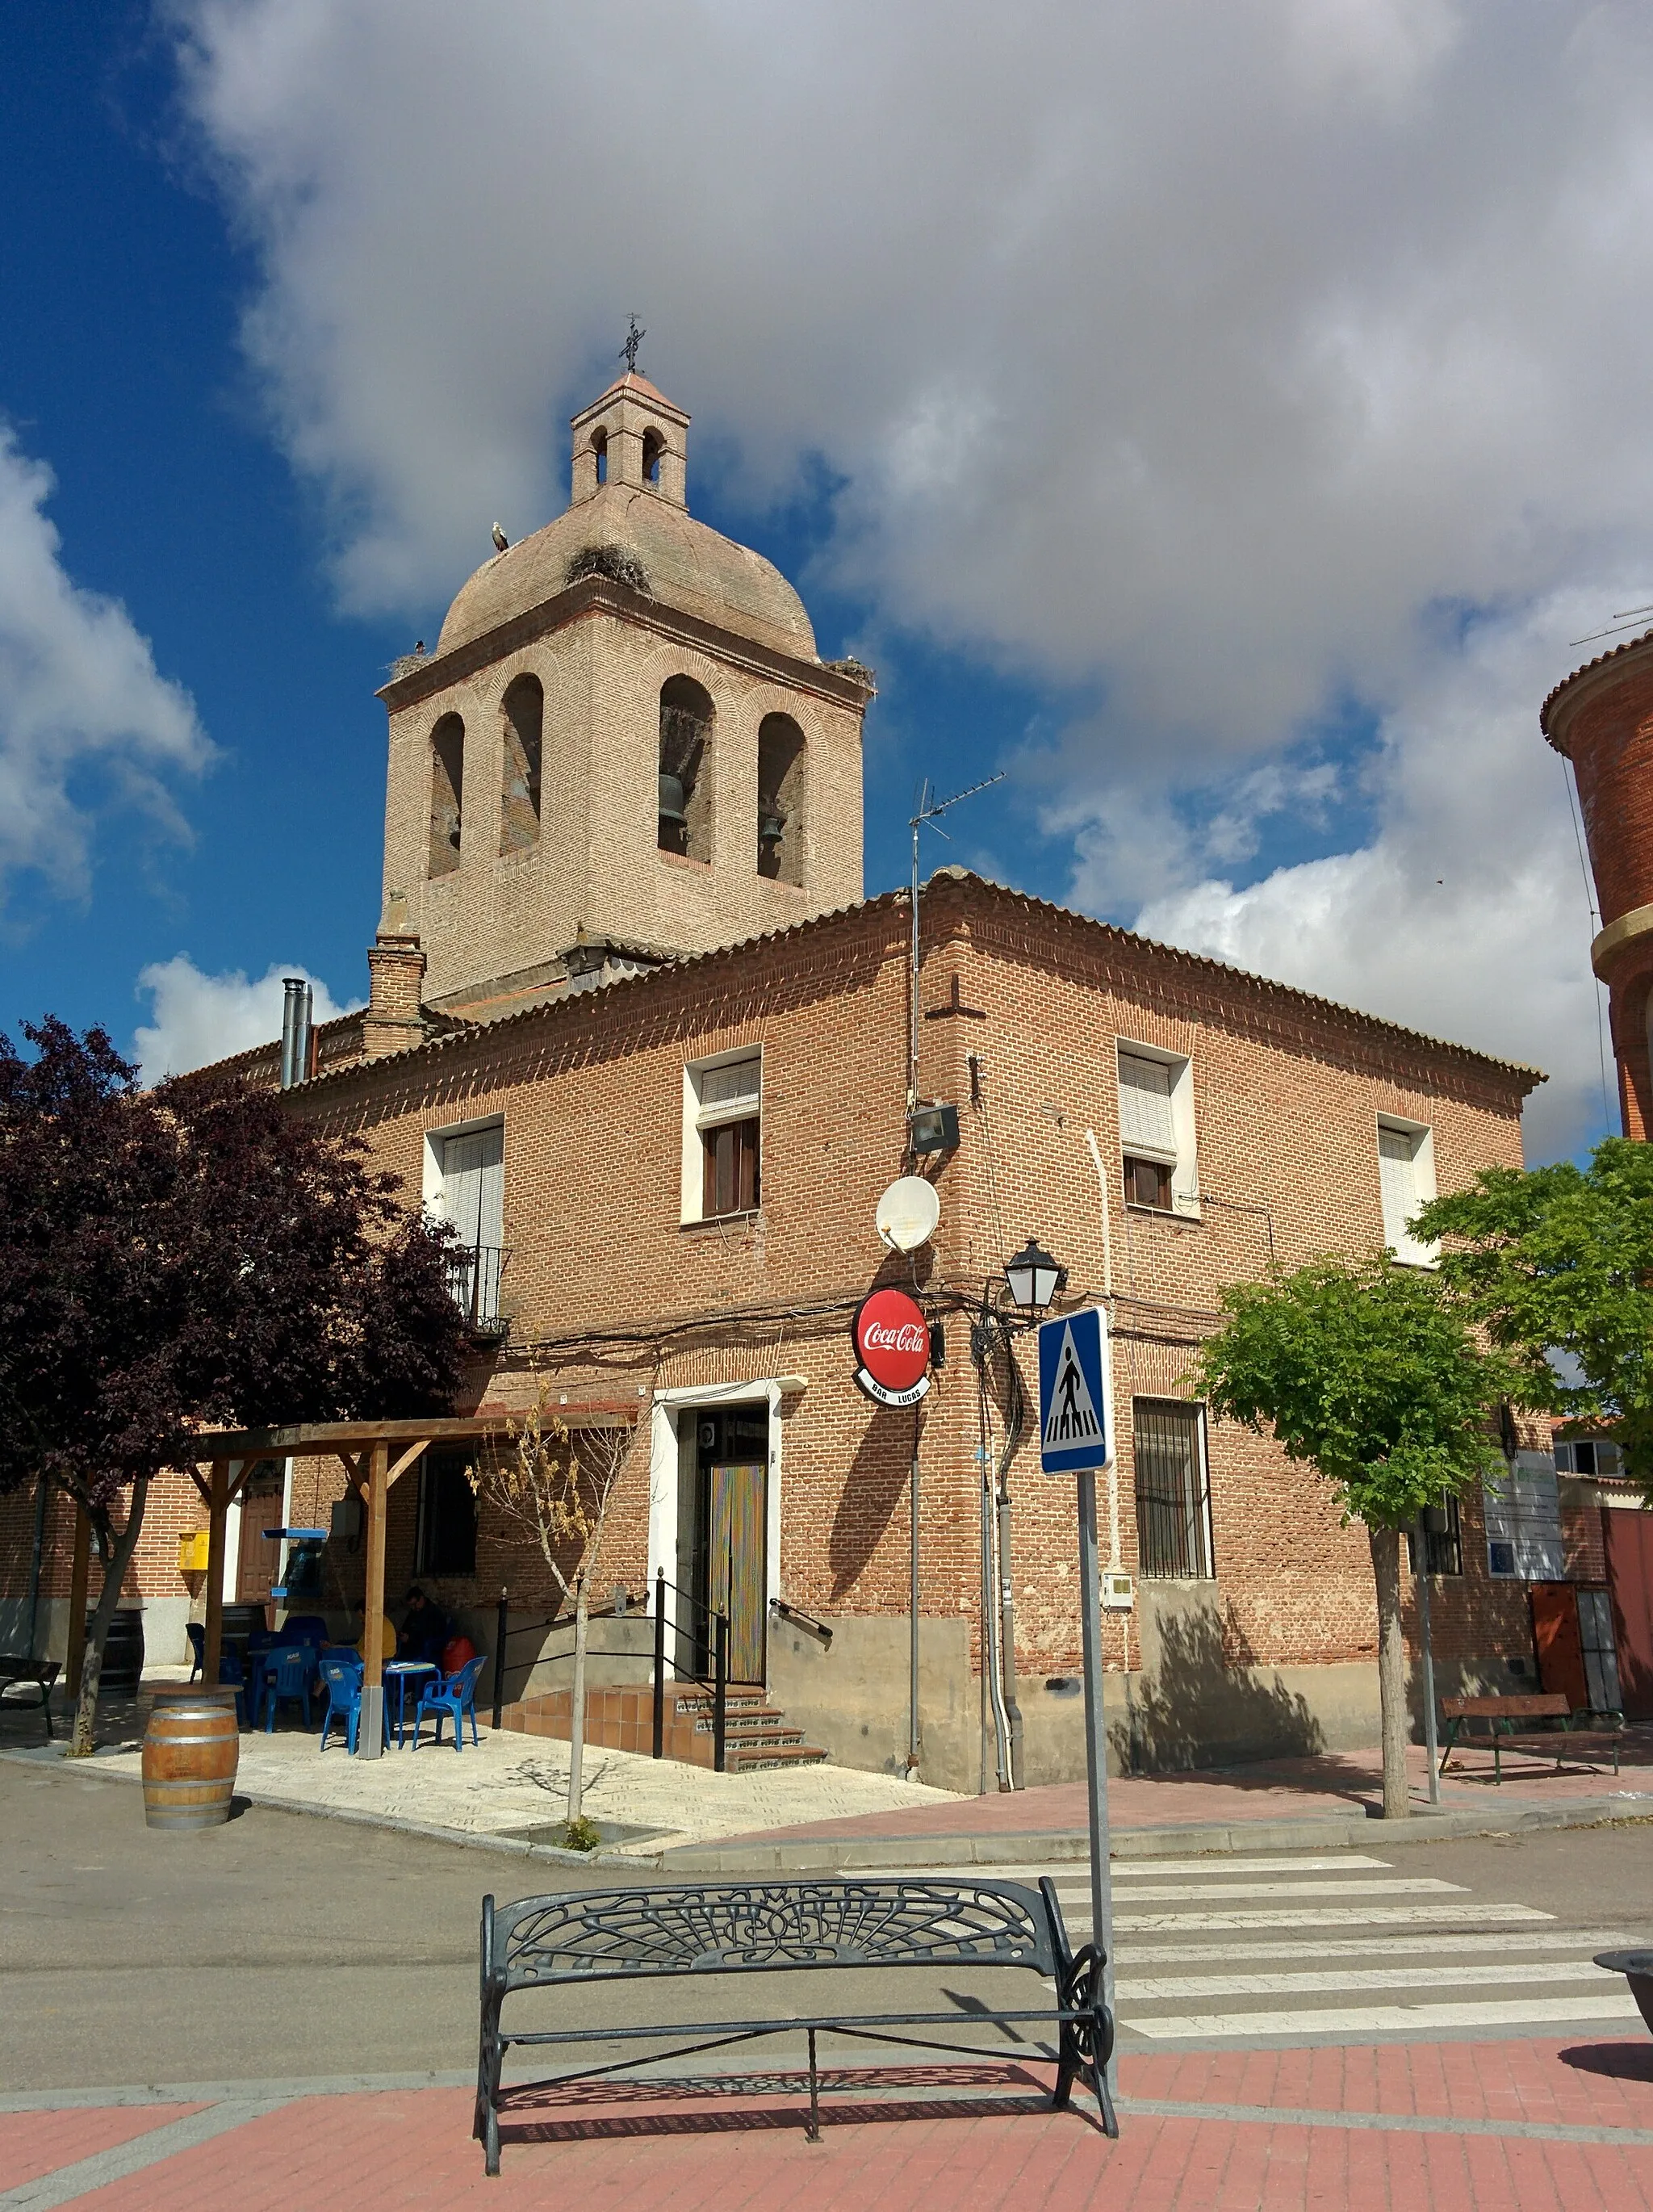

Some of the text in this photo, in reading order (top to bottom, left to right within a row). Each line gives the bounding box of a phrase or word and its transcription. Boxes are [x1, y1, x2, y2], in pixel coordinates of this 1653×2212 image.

[864, 1322, 925, 1352] Coca-Cola
[872, 1384, 921, 1403] BAR LUCAS
